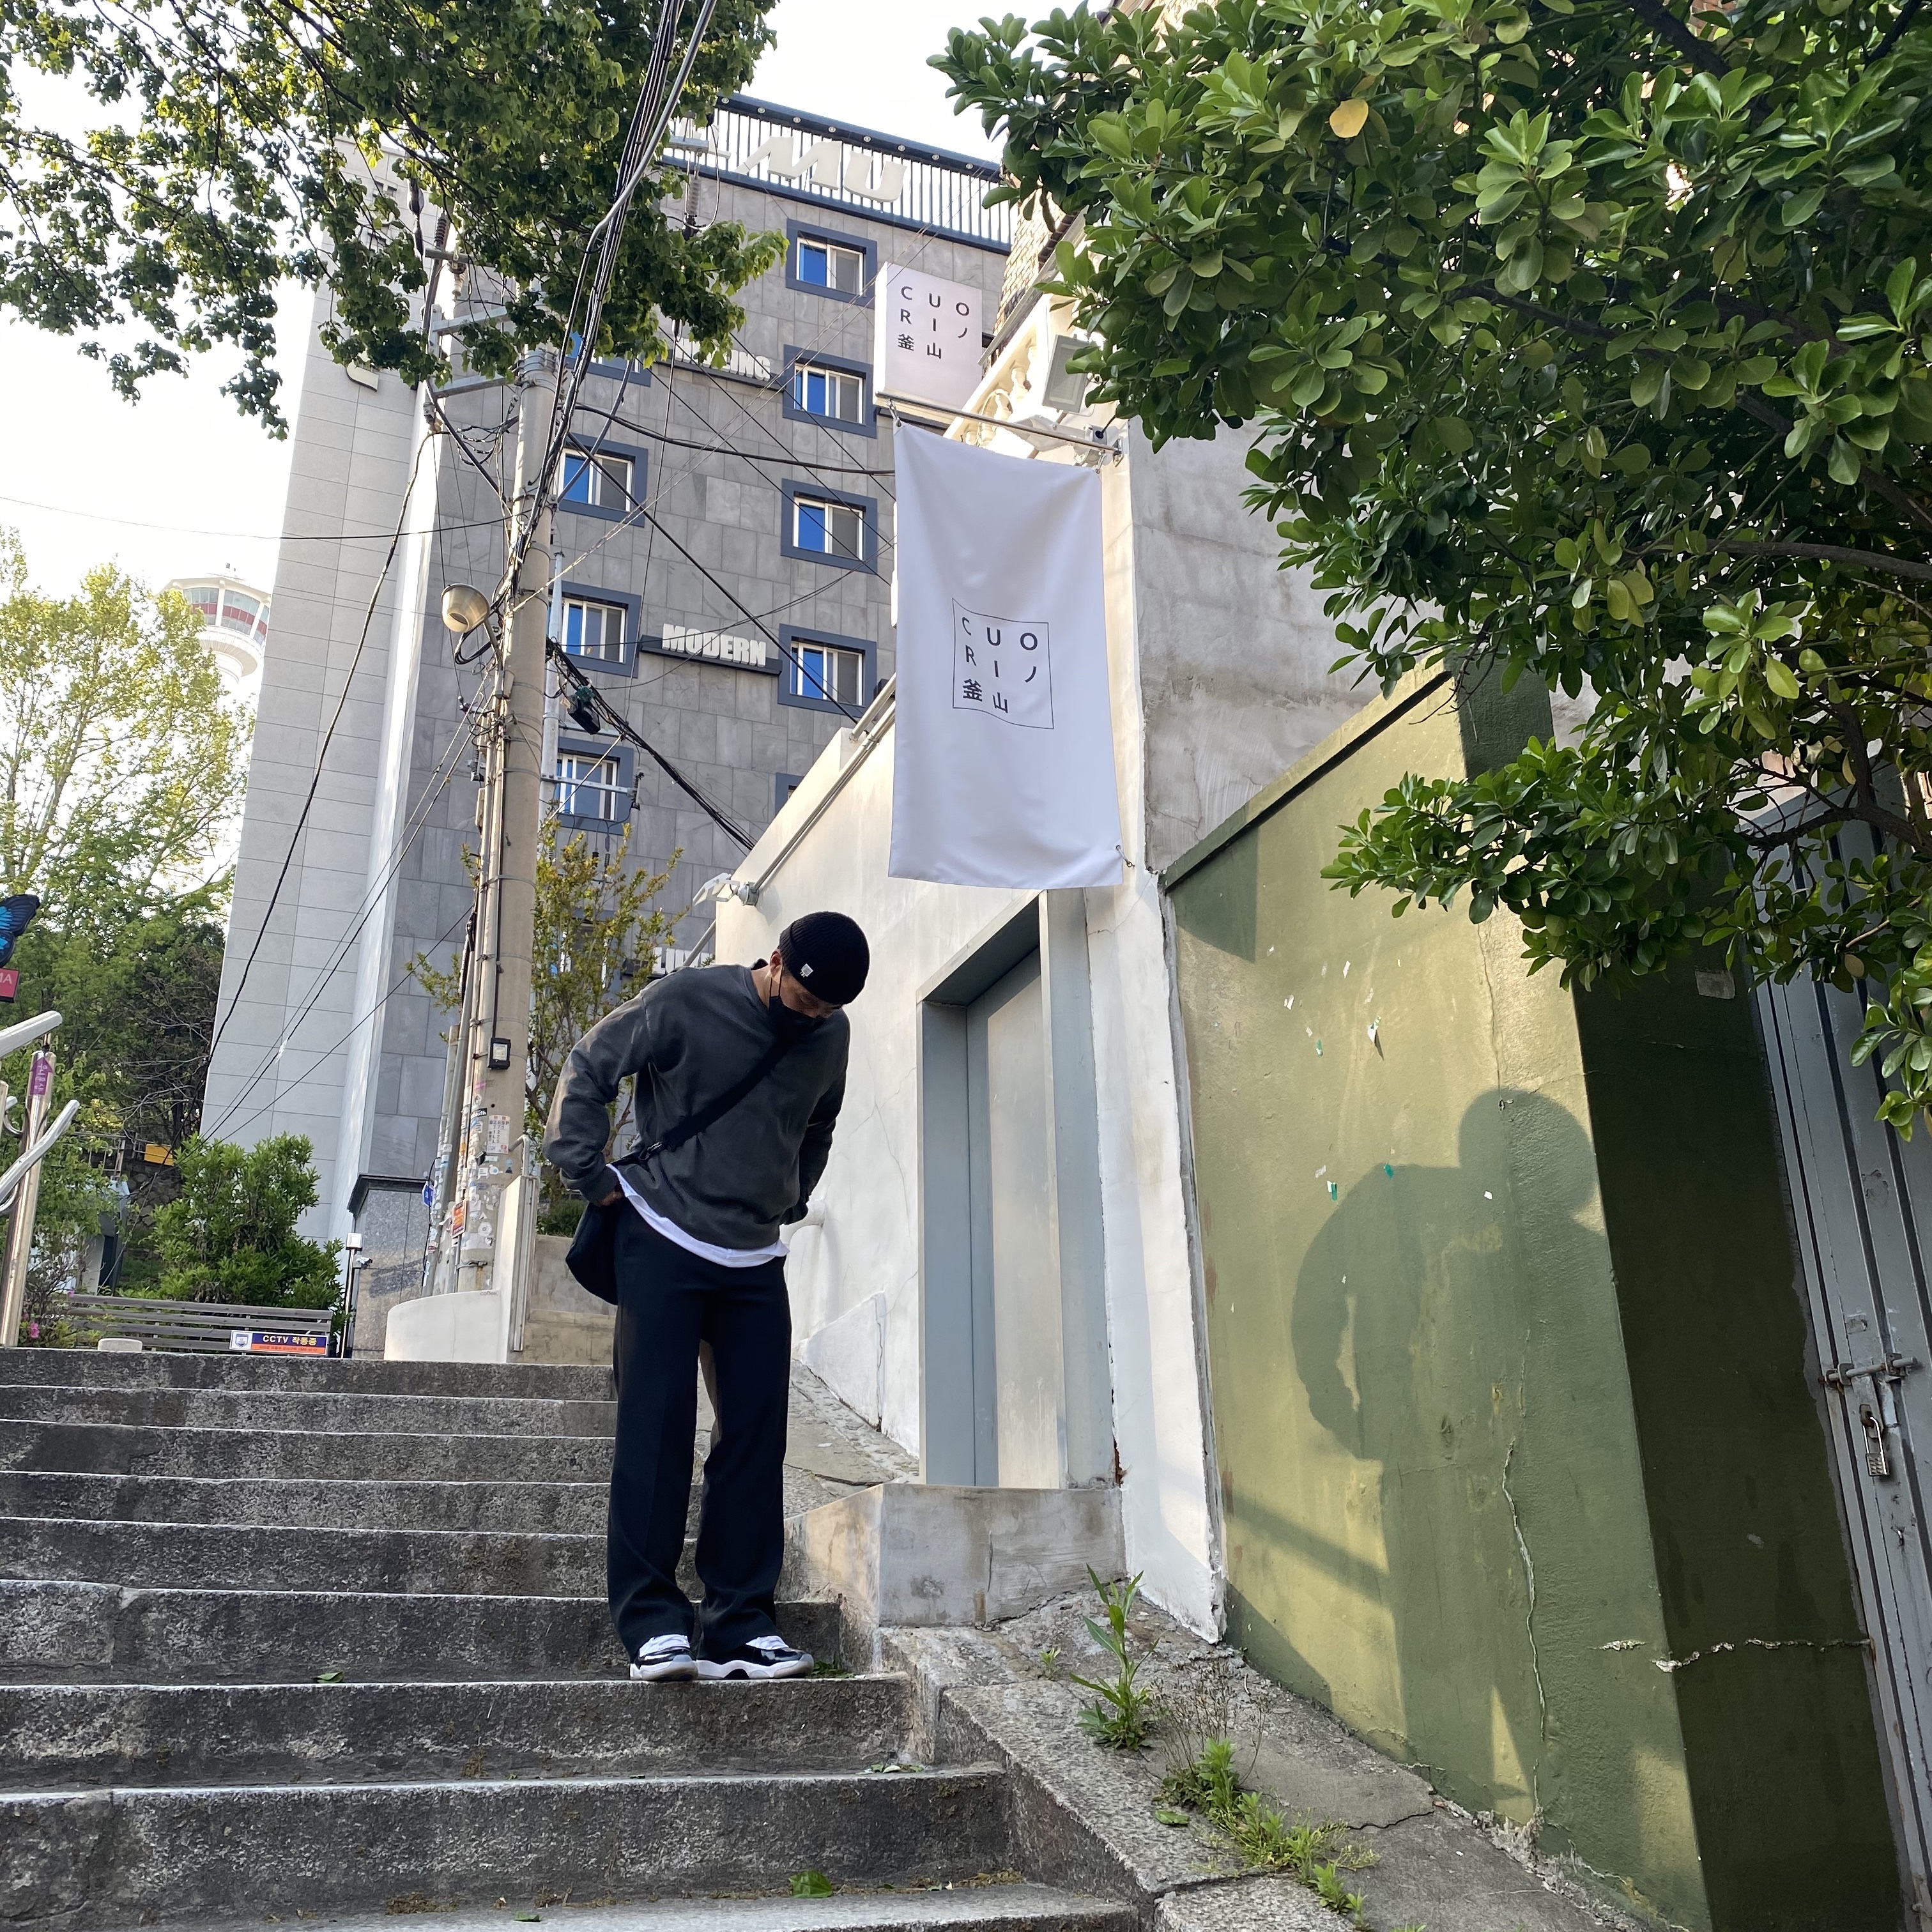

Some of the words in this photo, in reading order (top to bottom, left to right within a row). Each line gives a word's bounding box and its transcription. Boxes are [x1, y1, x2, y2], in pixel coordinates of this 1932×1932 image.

[897, 334, 942, 359] 釜山
[662, 623, 766, 668] MODERN
[962, 678, 1008, 713] 釜山
[263, 1335, 289, 1344] CCTV
[291, 1337, 318, 1346] 작동중
